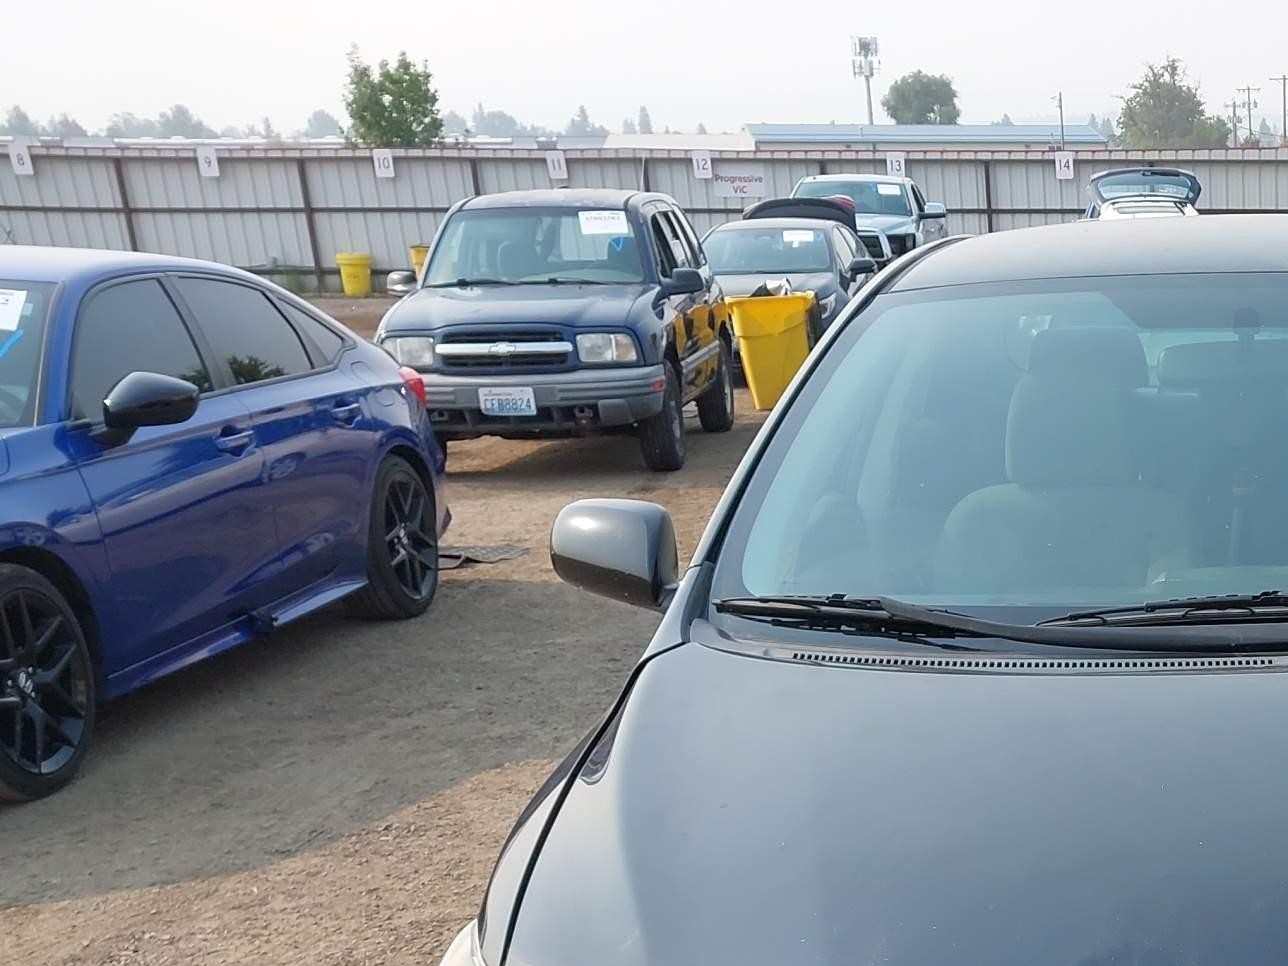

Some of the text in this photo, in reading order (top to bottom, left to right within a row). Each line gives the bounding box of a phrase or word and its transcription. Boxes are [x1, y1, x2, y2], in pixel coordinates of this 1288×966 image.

[203, 155, 212, 168] 9
[376, 157, 390, 169] 10
[551, 158, 562, 171] 11
[695, 158, 709, 171] 12
[890, 159, 902, 172] 13
[1058, 158, 1071, 171] 14
[714, 174, 763, 184] Progressive
[732, 185, 748, 194] VIC
